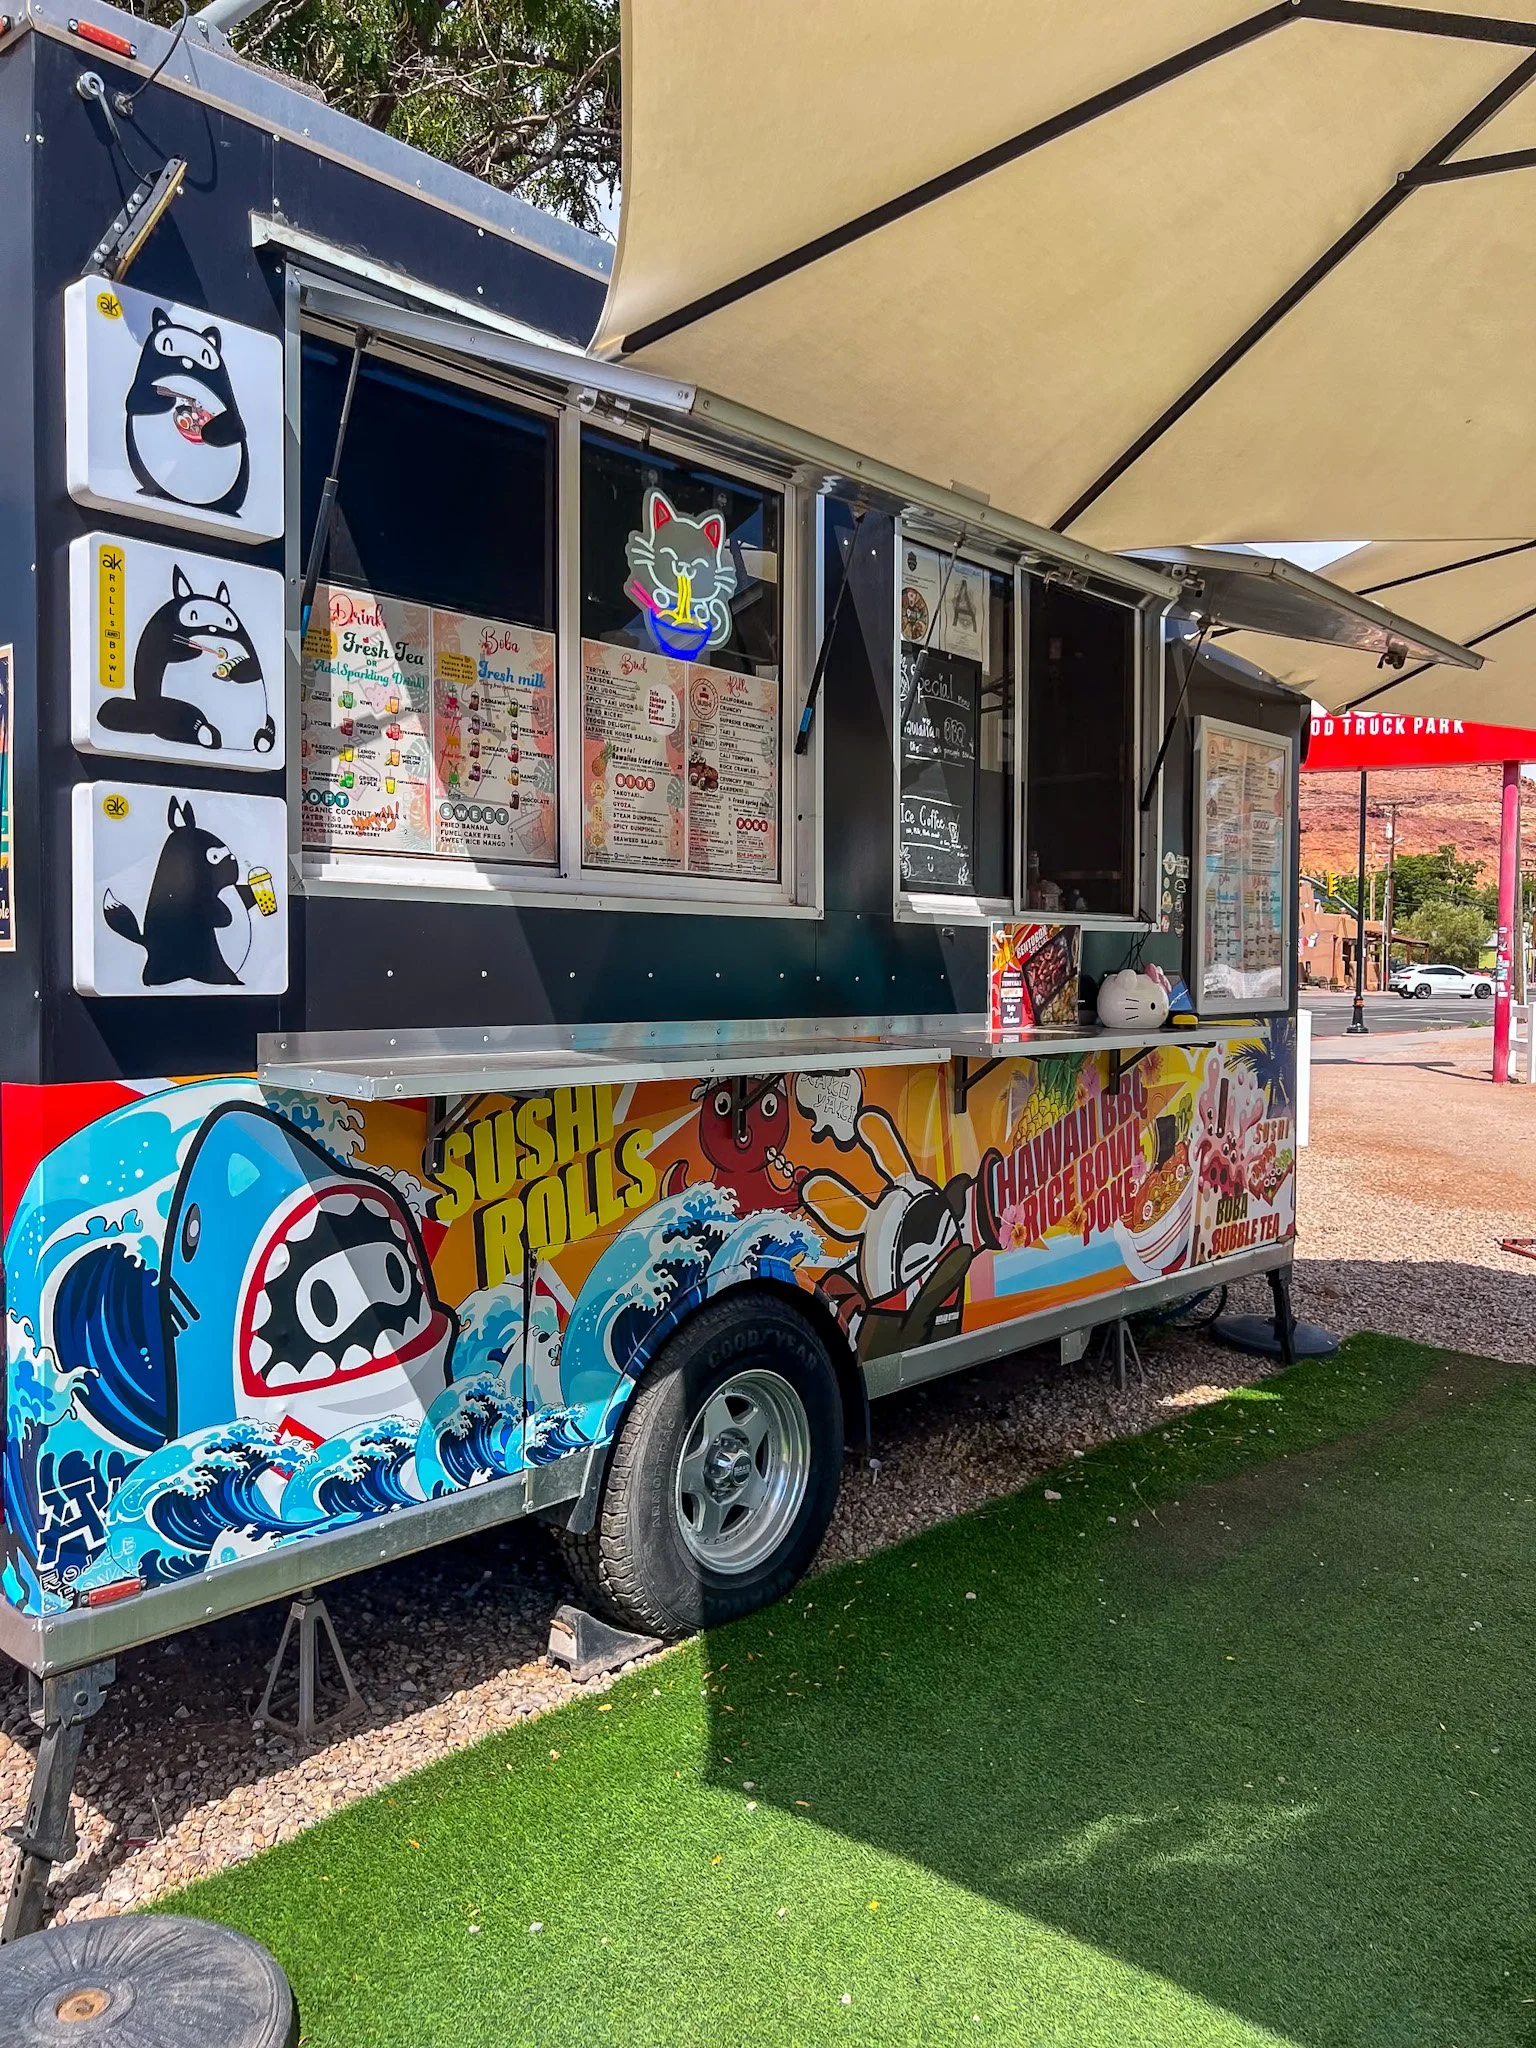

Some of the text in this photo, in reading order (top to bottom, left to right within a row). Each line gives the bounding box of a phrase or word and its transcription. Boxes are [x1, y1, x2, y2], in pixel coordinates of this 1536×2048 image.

[329, 593, 388, 629] Drink
[343, 631, 389, 659] Fresh
[395, 641, 424, 666] Tea
[481, 626, 520, 655] Boba
[366, 659, 377, 667] OR
[478, 660, 546, 689] Fresh milk
[356, 722, 379, 730] DRAGON
[585, 725, 613, 736] JAPANESE
[614, 730, 633, 738] HOUSE
[634, 734, 652, 742] SALAD
[1342, 717, 1405, 736] TRUCK
[1413, 717, 1464, 735] PARK
[519, 751, 553, 760] STRAWBERRY
[612, 789, 640, 798] TAKOYAKI
[616, 774, 655, 791] BITE
[302, 790, 348, 807] OFT
[519, 797, 550, 805] CHOCOLATE
[335, 809, 371, 817] COCONUT
[374, 811, 400, 819] WATER
[441, 803, 508, 824] SWEET
[736, 818, 768, 832] POKE
[900, 803, 945, 830] Ice Coffee
[440, 836, 464, 844] SWEET
[482, 839, 506, 847] MANGO
[813, 1093, 856, 1123] YAKI
[998, 1067, 1148, 1207] HAWAII BBQ
[1255, 1118, 1290, 1145] SUSHI
[430, 1085, 614, 1220] SUSHI
[1021, 1119, 1145, 1248] RICE BOWL
[476, 1129, 656, 1289] ROLLS
[1082, 1175, 1137, 1247] POKE
[1215, 1192, 1248, 1222] BOBA
[1211, 1212, 1281, 1255] BUBBLE TEA
